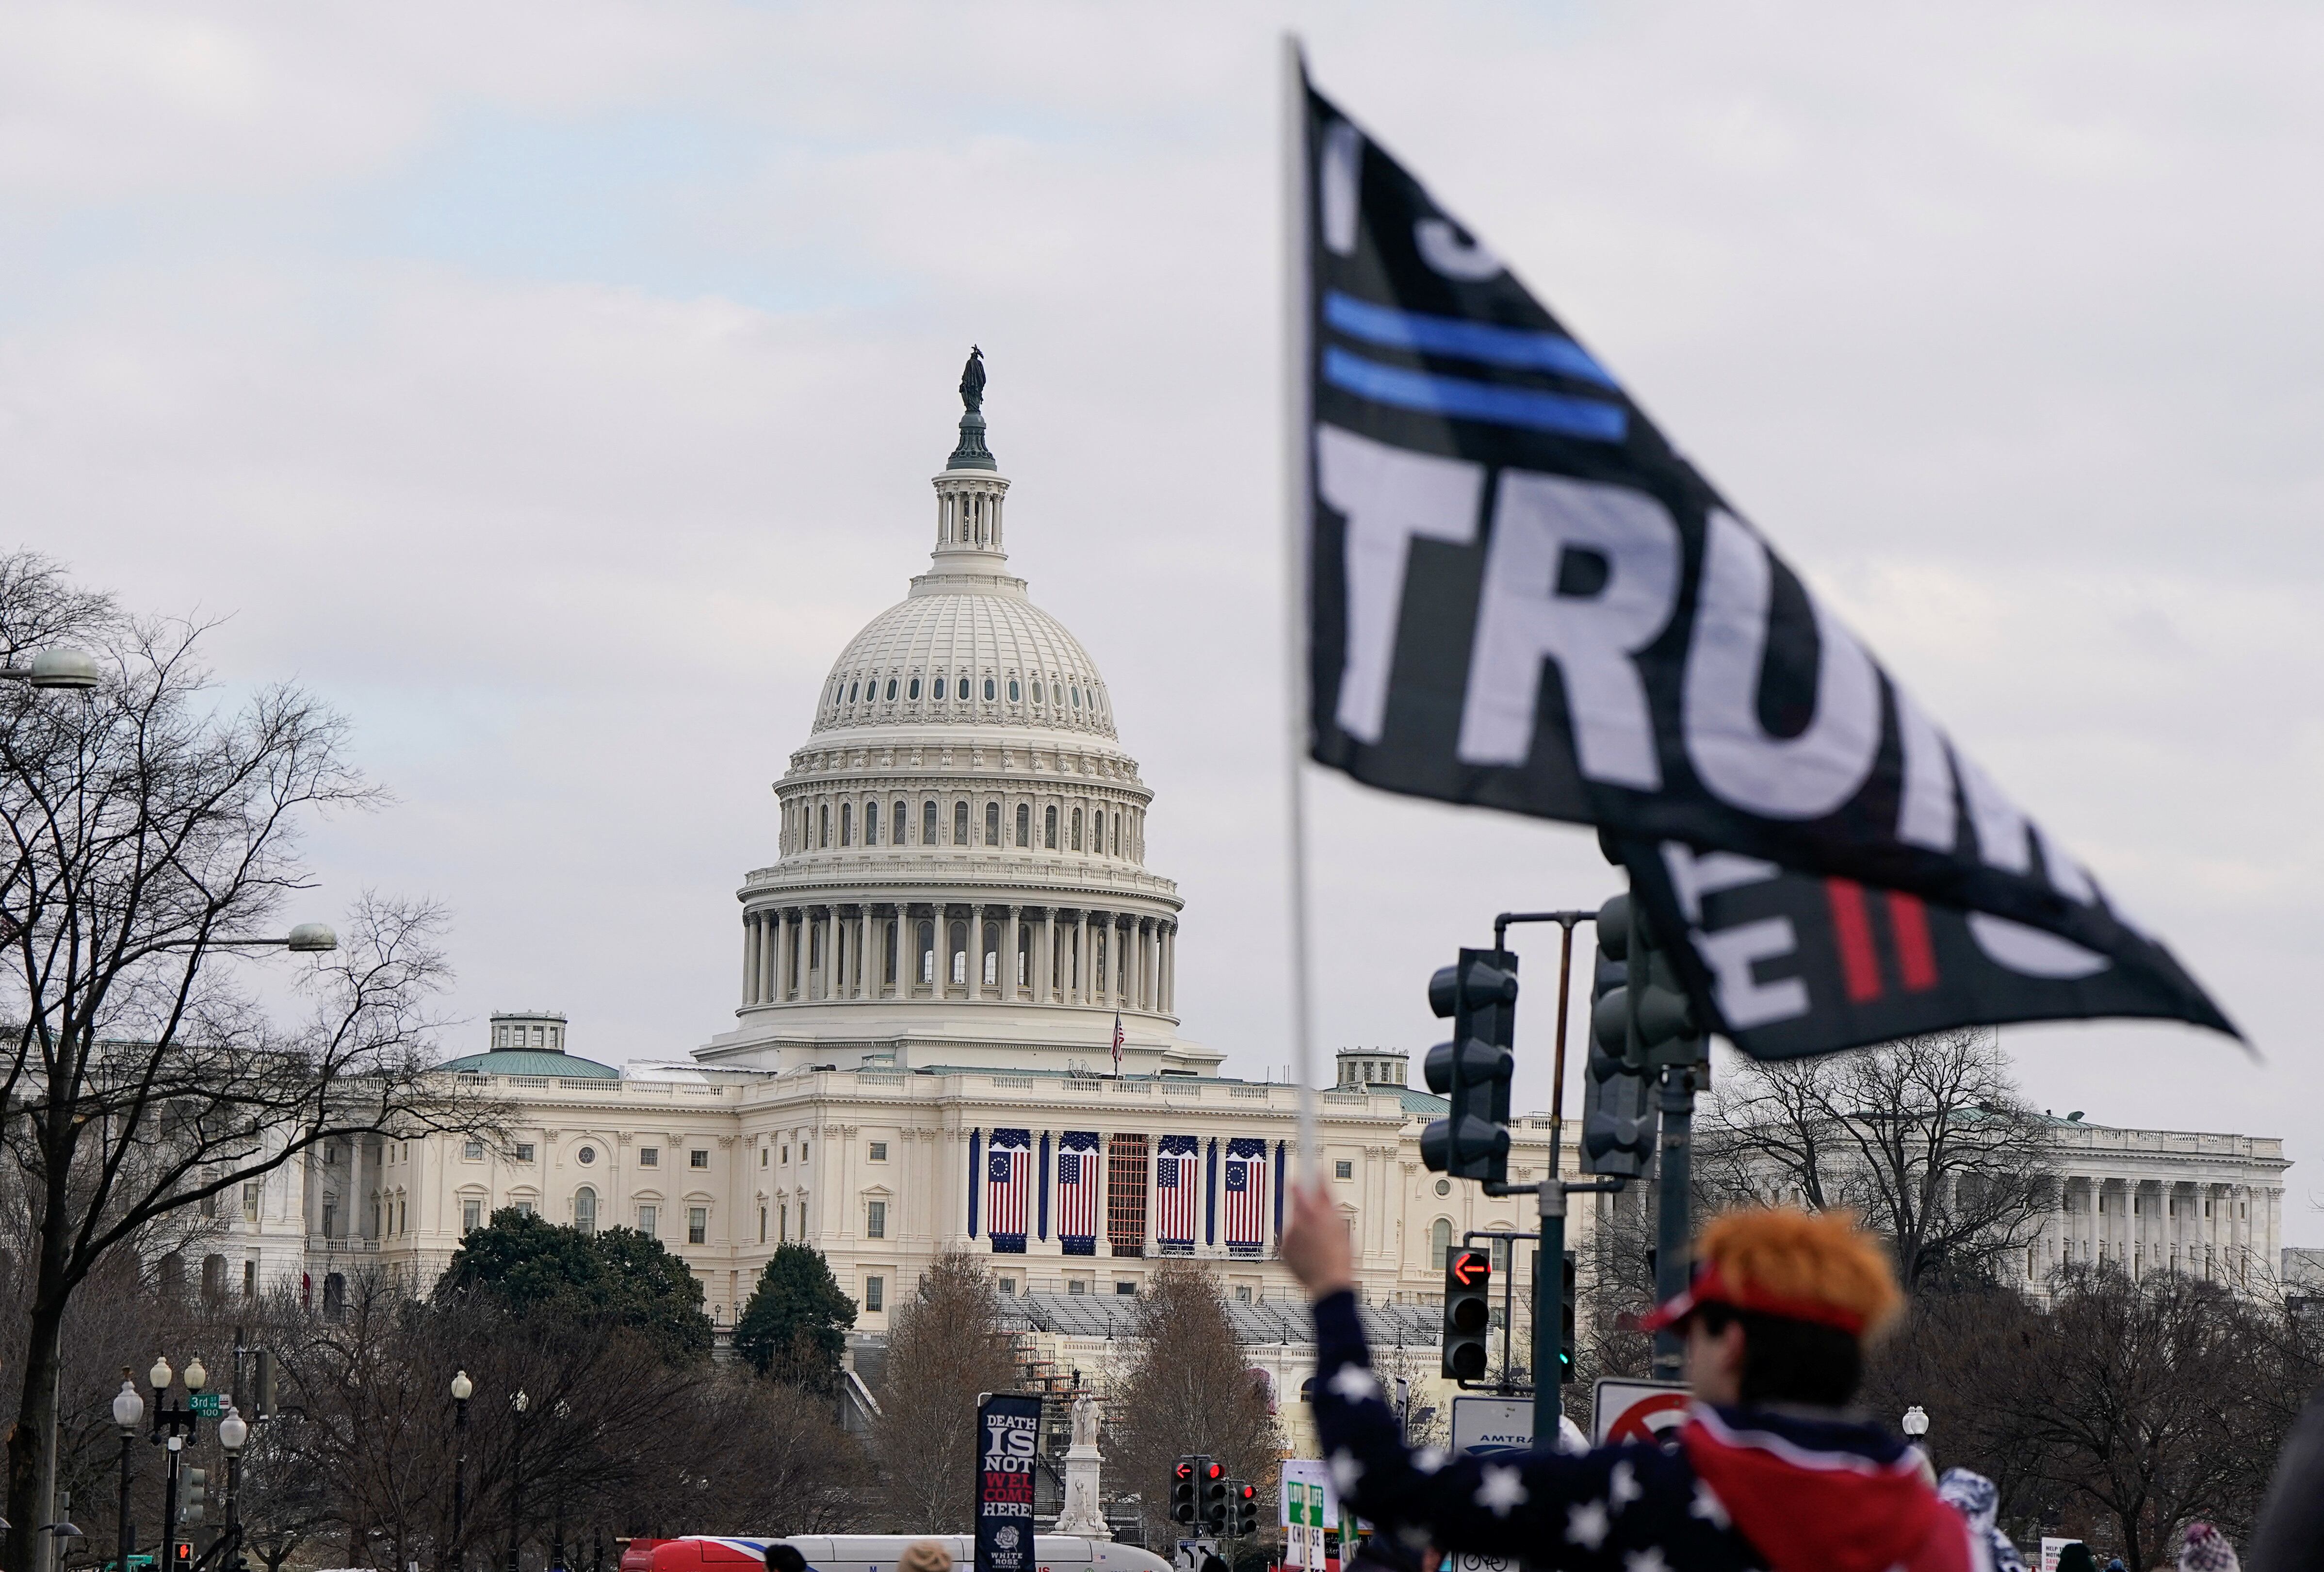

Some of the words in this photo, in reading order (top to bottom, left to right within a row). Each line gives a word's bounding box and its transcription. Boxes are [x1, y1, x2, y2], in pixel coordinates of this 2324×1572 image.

[191, 1397, 208, 1407] 3rd
[987, 1415, 1037, 1430] DEATH
[985, 1427, 1035, 1457] IS
[1480, 1435, 1534, 1443] AMTRA
[983, 1456, 1034, 1474] NOT
[985, 1473, 1033, 1489] WEL
[983, 1488, 1033, 1503] COME
[1289, 1484, 1303, 1504] LOV
[982, 1502, 1032, 1518] HERE!
[1293, 1526, 1319, 1547] CHSE
